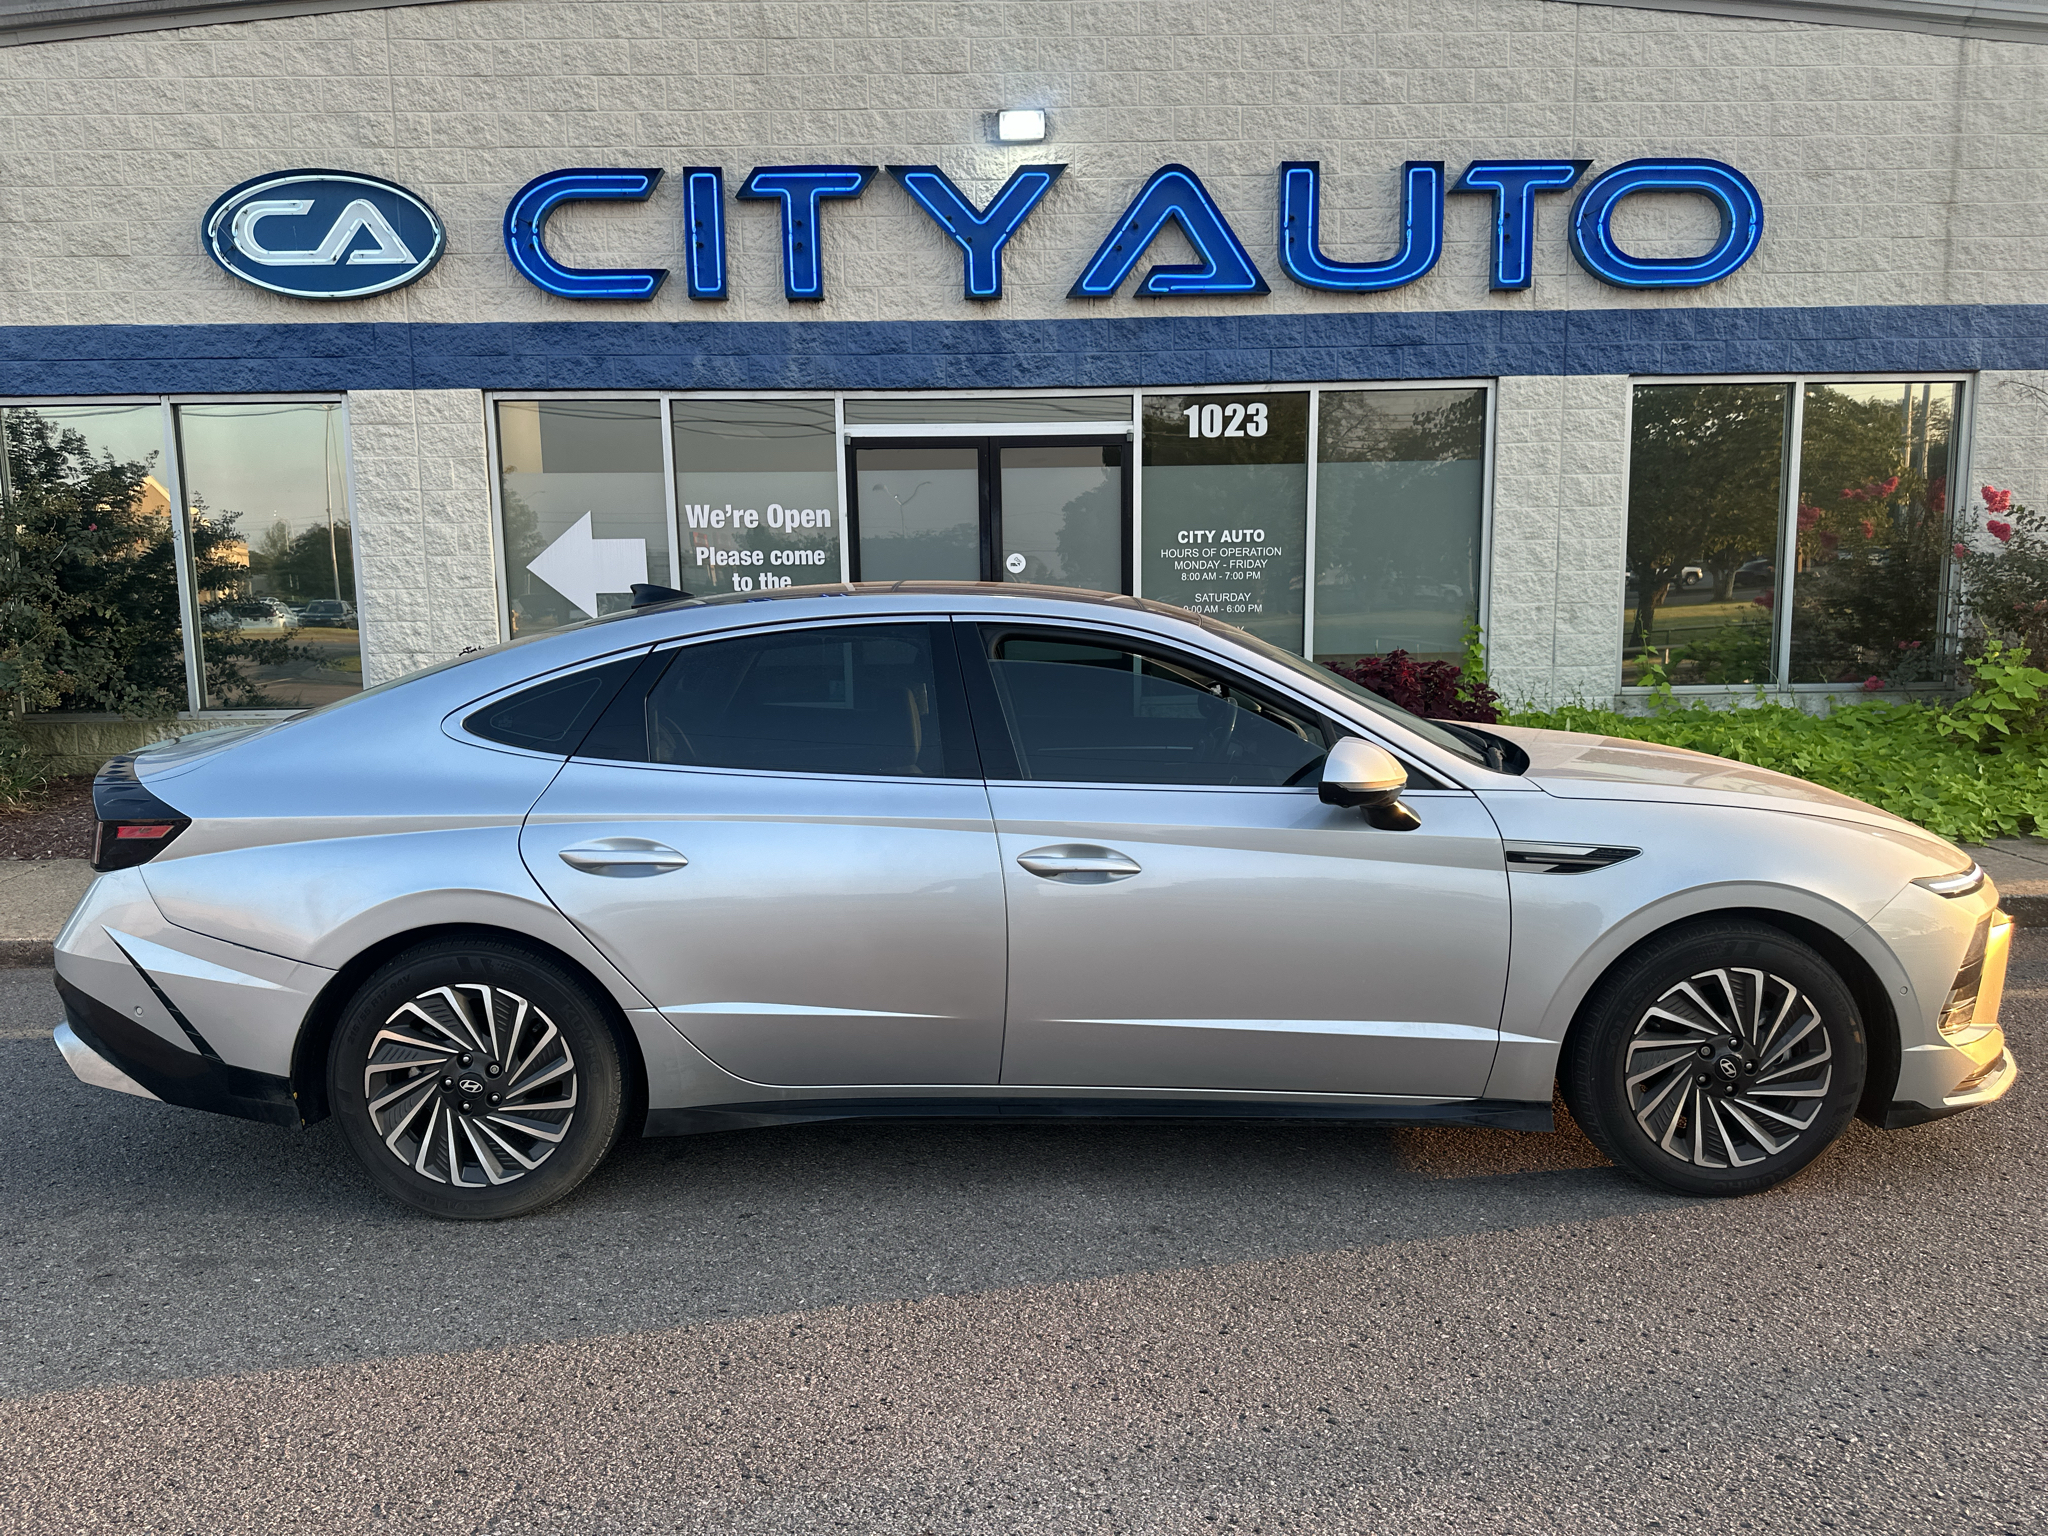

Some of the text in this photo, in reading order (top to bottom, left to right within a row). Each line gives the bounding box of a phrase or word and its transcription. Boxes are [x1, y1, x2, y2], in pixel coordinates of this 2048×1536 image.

[233, 198, 420, 266] CA
[503, 158, 1764, 302] CITY AUTO
[1183, 402, 1269, 438] 1023
[684, 503, 832, 534] We're Open
[1177, 528, 1266, 544] CITY AUTO
[695, 546, 826, 566] Please come
[1160, 546, 1282, 558] HOURS OF OPERATION
[1174, 560, 1220, 570] MONDAY
[1229, 559, 1269, 569] FRIDAY
[731, 571, 793, 592] to the
[1181, 572, 1201, 581] 8:00
[1202, 571, 1217, 581] AM
[1224, 571, 1244, 580] 7:00
[1246, 570, 1261, 580] PM
[1194, 592, 1252, 603] SATURDAY
[1203, 604, 1219, 613] AM
[1226, 604, 1246, 613] 6:00
[1247, 603, 1263, 613] PM
